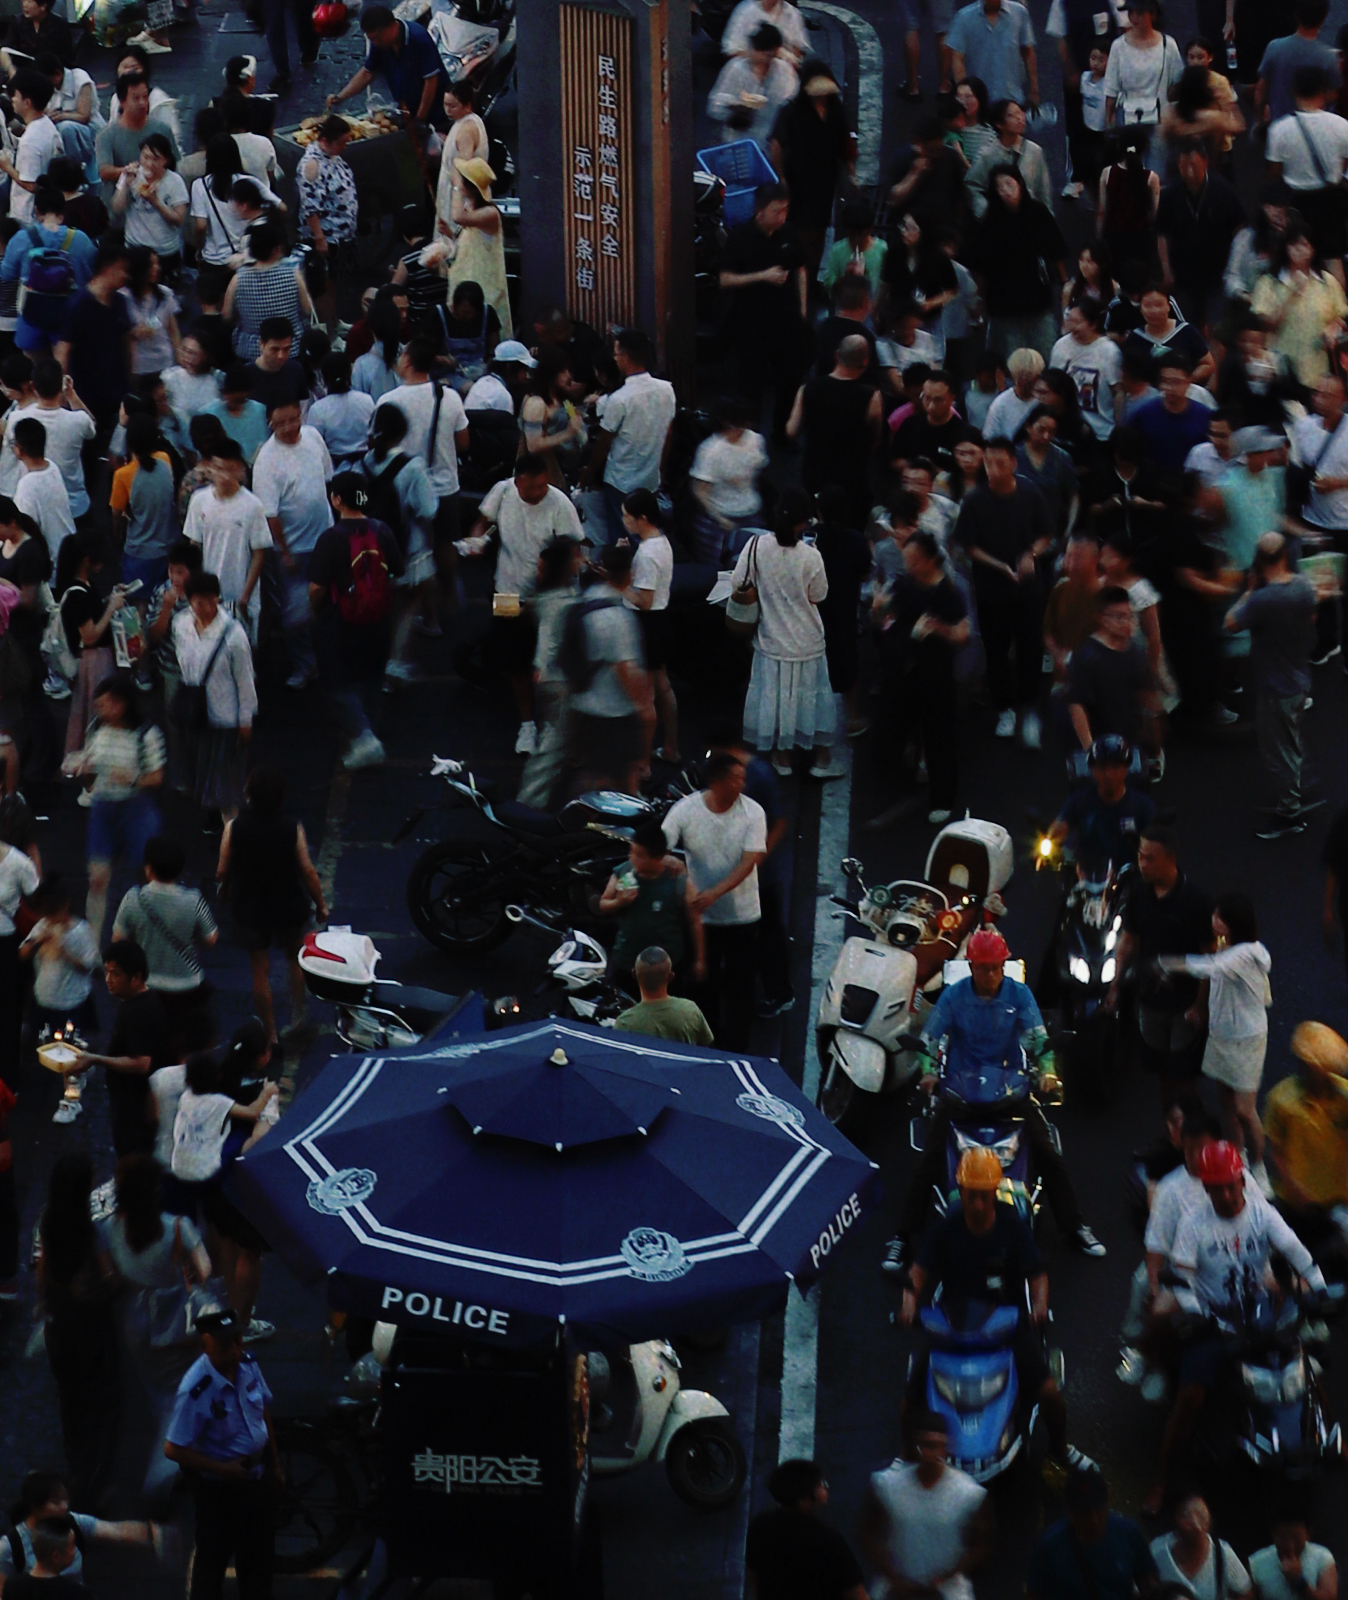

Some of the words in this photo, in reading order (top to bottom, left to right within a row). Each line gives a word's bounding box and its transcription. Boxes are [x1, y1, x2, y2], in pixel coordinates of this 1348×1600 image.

[597, 54, 620, 259] 民生路燃气安全
[572, 145, 595, 291] 示范一条街
[809, 1193, 862, 1269] POLICE
[381, 1285, 511, 1335] POLICE
[411, 1446, 543, 1493] 贵阳公安
